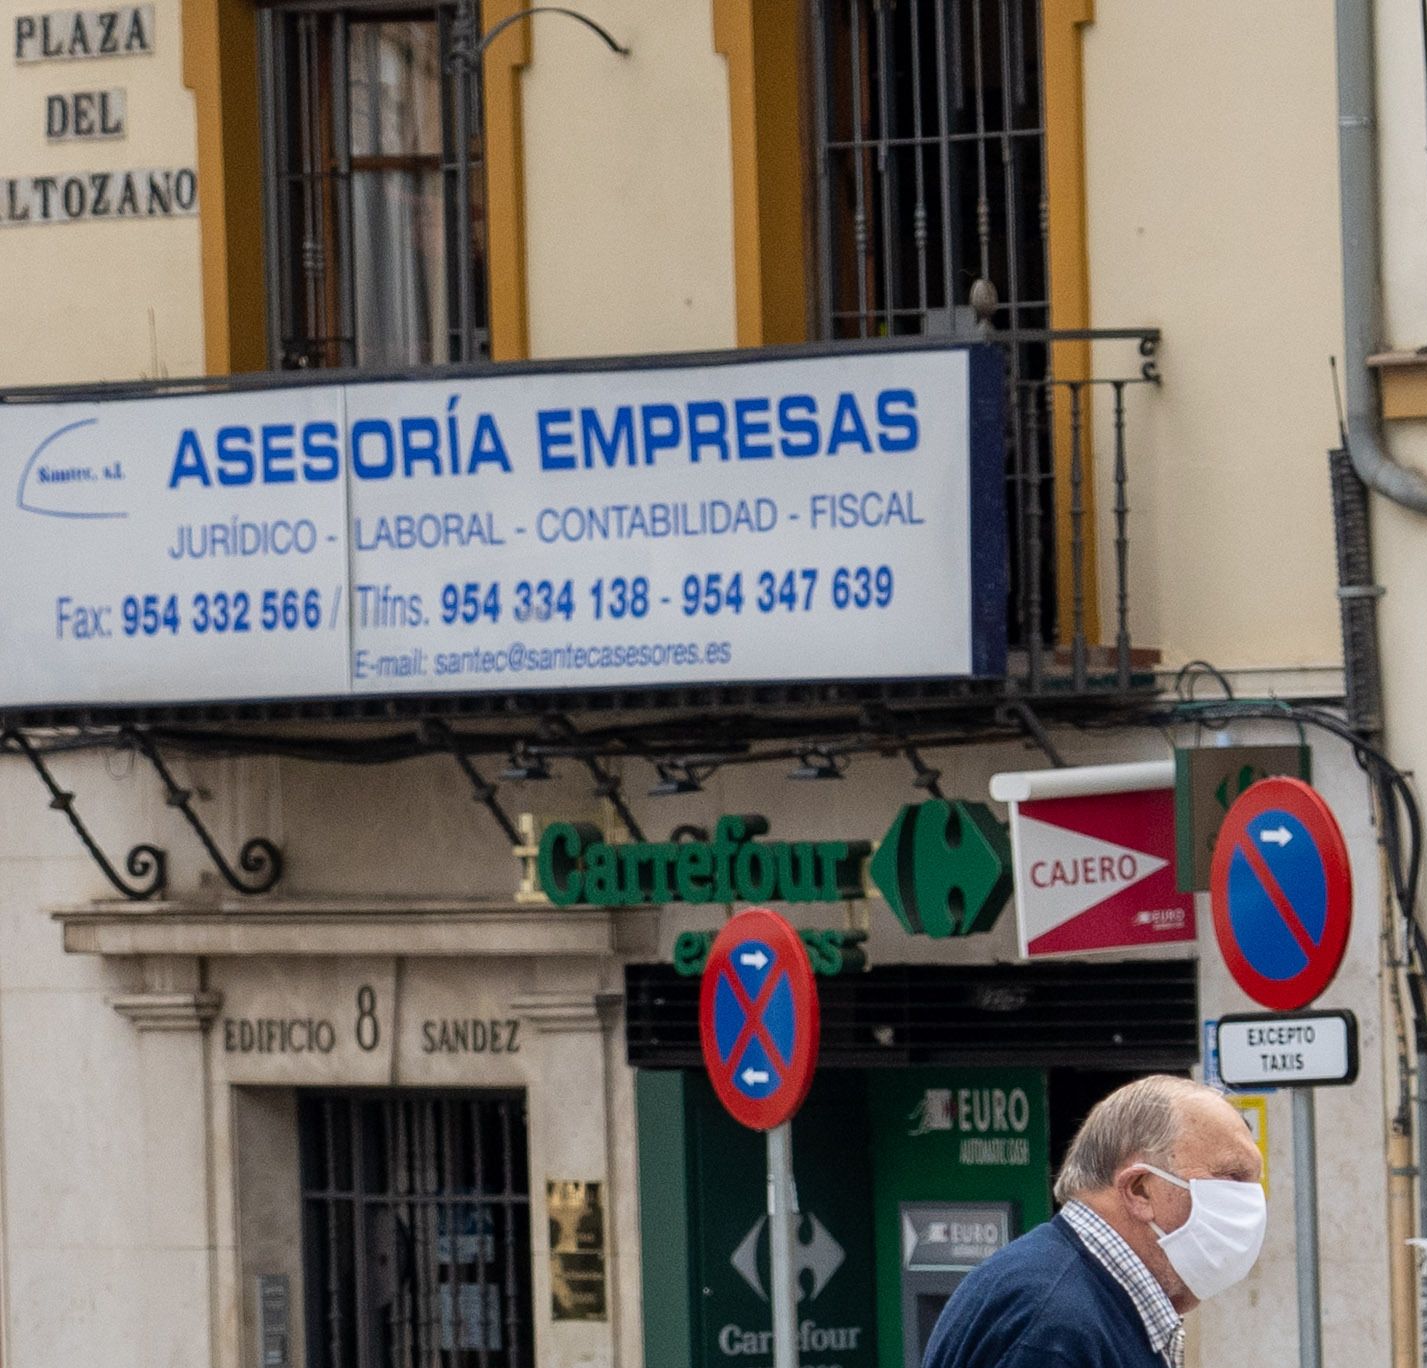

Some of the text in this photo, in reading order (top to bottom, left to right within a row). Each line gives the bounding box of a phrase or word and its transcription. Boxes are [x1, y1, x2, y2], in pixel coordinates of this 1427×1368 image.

[15, 8, 149, 59] PLAZA
[46, 91, 122, 138] DEL
[0, 168, 197, 220] LTOZANO
[168, 388, 921, 489] ASESORÍA EMPRESAS
[168, 515, 318, 560] JURÍDICO
[354, 511, 506, 552] LABORAL
[537, 497, 778, 544] CONTABILIDAD
[810, 491, 924, 529] FISCAL
[56, 596, 112, 640] Fax:
[122, 592, 181, 637] 954
[192, 591, 251, 634] 332
[261, 588, 322, 632] 566
[356, 585, 430, 628] Tlfns.
[441, 582, 502, 625] 954
[514, 578, 575, 623] 334
[591, 576, 650, 621] 138
[681, 572, 745, 617] 954
[757, 568, 818, 614] 347
[832, 566, 894, 611] 639
[354, 640, 732, 680] E-mail: santec@santecasesores.es
[537, 814, 850, 908] Carrefour
[1029, 853, 1139, 889] CAJERO
[224, 984, 521, 1055] EDIFICIO 8 SANDEZ
[1247, 1025, 1316, 1046] EXCEPTO
[1261, 1053, 1305, 1071] TAXIS
[957, 1086, 1030, 1133] EURO
[950, 1222, 999, 1244] EURO
[718, 1319, 861, 1356] Carfour
